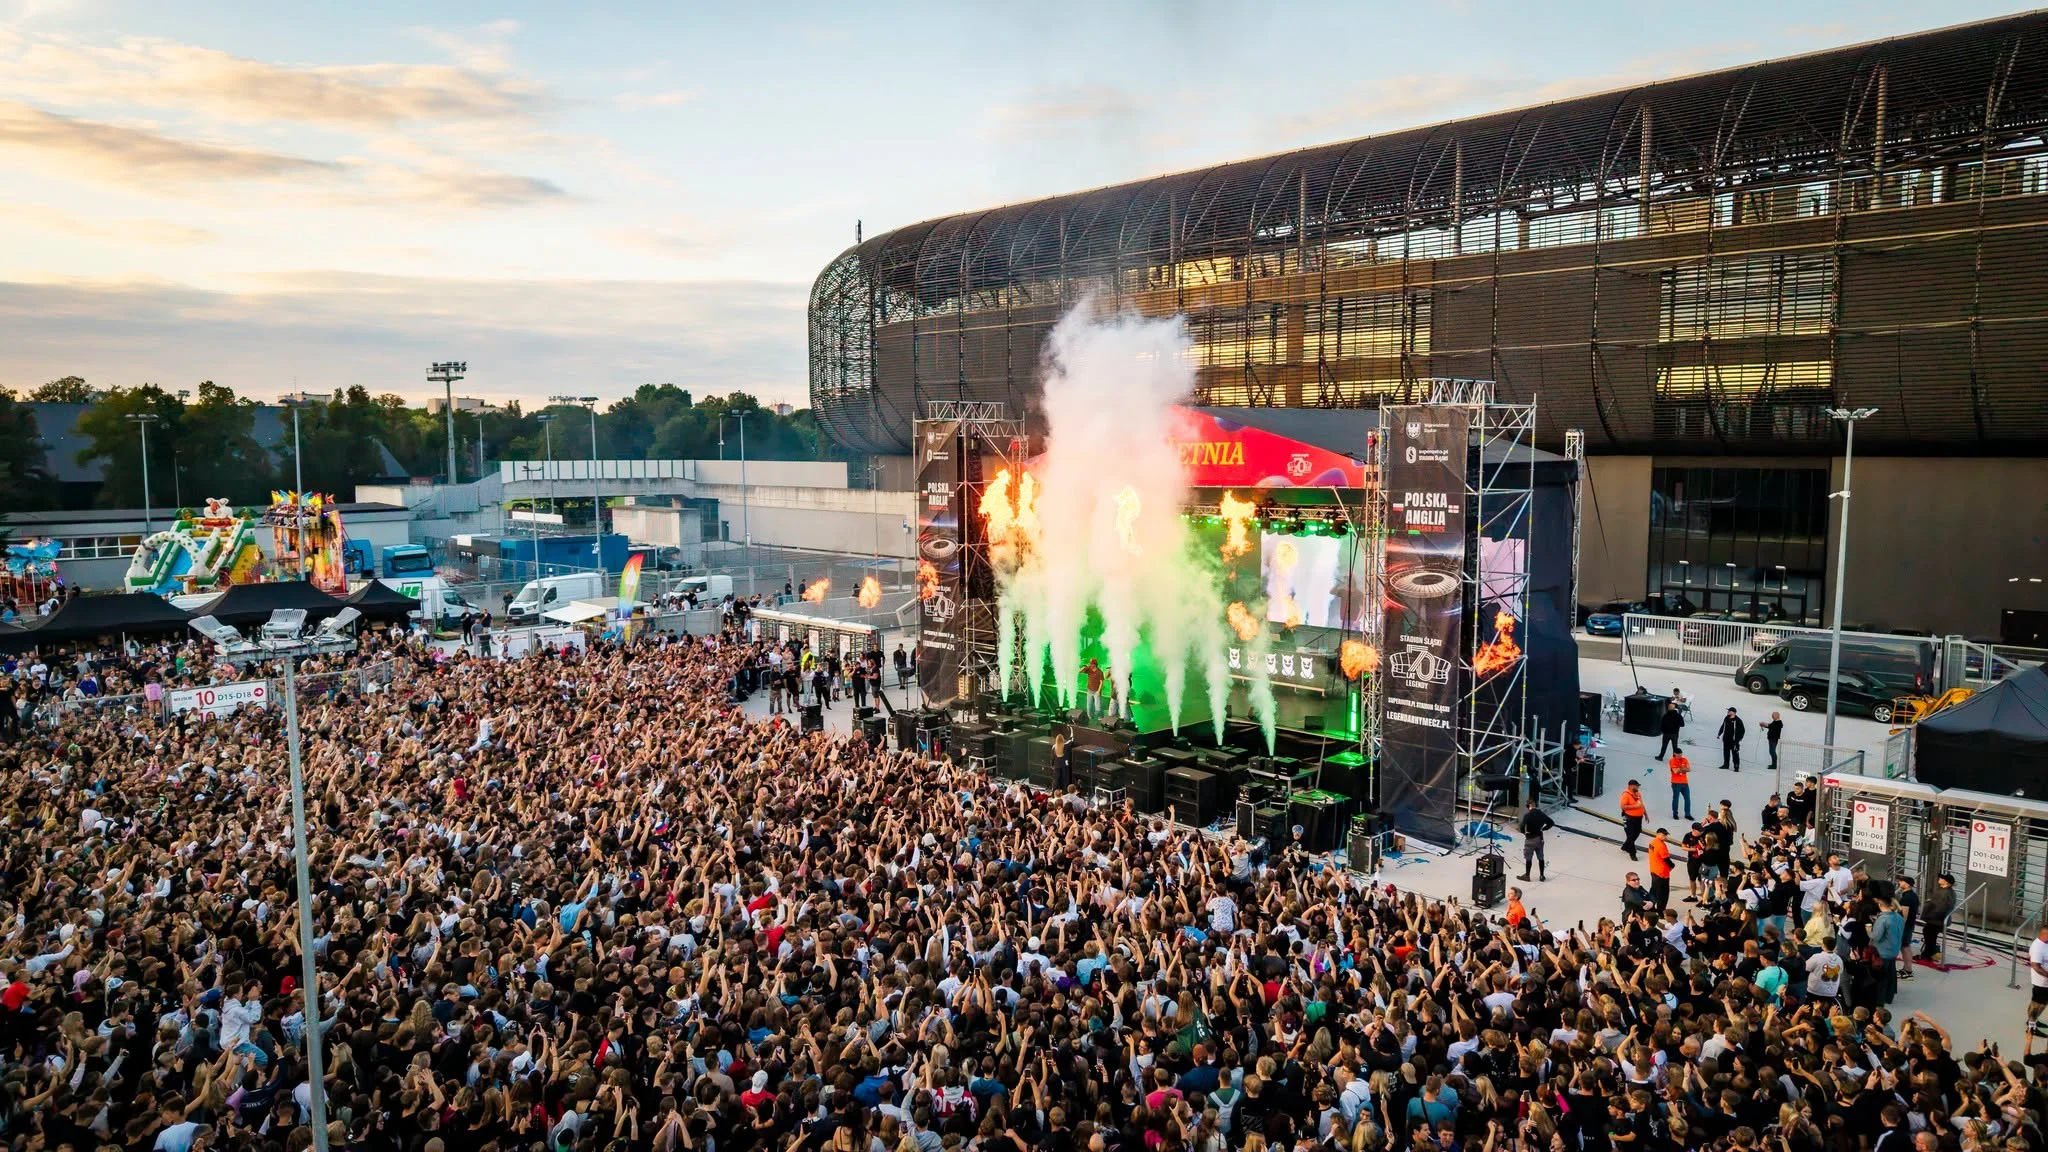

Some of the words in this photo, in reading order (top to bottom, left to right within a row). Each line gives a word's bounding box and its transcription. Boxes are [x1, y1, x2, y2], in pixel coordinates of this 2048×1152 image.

[1171, 438, 1245, 465] ETNIA
[928, 482, 949, 493] POLSKA
[1405, 492, 1447, 508] POLSKA
[1405, 509, 1446, 526] ANGLIA
[1406, 679, 1429, 689] LEGENDY
[196, 690, 215, 706] 10
[218, 691, 252, 701] D15-D18
[1386, 710, 1451, 729] LEGENDARNYMECZ.PL
[1869, 815, 1884, 830] 11
[1855, 830, 1884, 840] D01-D03
[1989, 835, 2005, 850] 11
[1854, 840, 1883, 850] D11-D14
[1973, 850, 2005, 862] D01-D03
[1972, 861, 2003, 873] D11-D14
